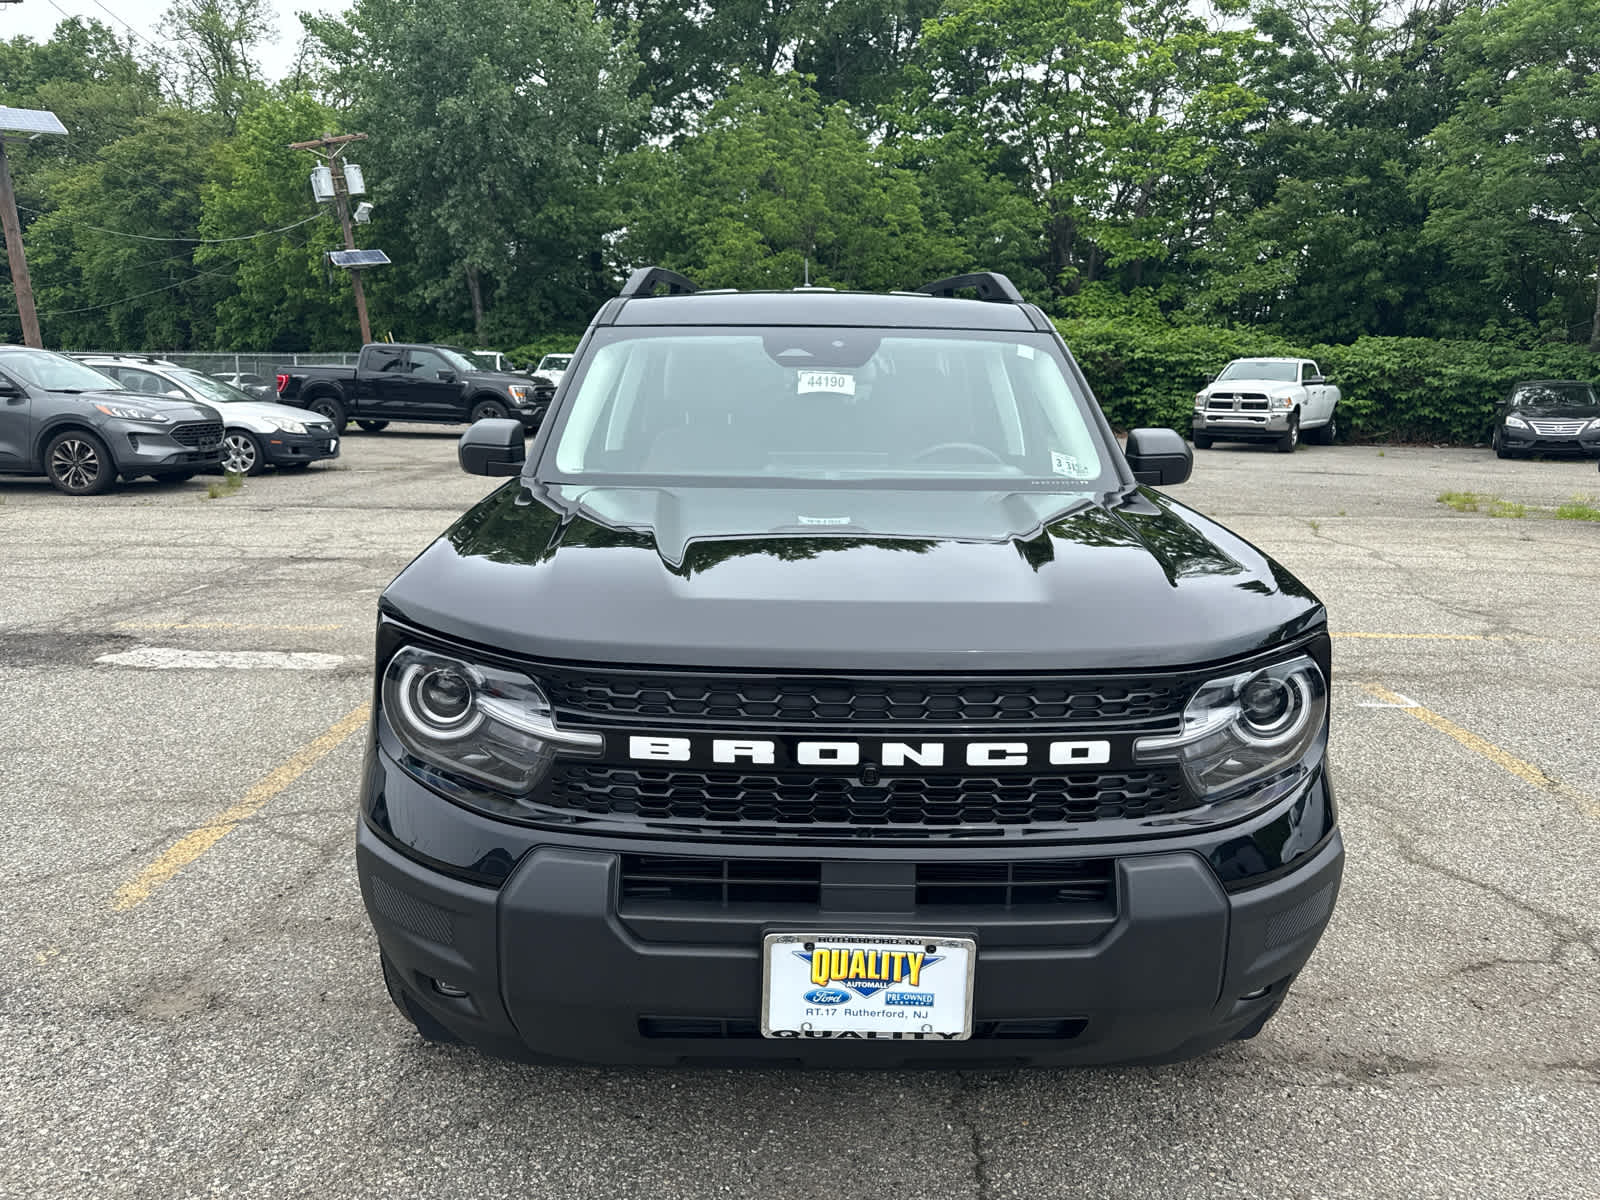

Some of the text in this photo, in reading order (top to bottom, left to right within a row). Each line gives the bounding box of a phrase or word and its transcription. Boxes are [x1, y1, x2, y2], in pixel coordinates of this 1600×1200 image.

[807, 375, 846, 388] 44190
[629, 735, 1111, 767] BRONCO
[810, 948, 925, 987] QUALITY
[846, 980, 888, 989] AUTOMALL
[812, 991, 842, 1003] Ford
[887, 993, 933, 1003] PRE-OWNED
[844, 1008, 908, 1019] Rutherford,
[913, 1010, 929, 1019] NJ
[771, 1030, 960, 1040] QUALITY
